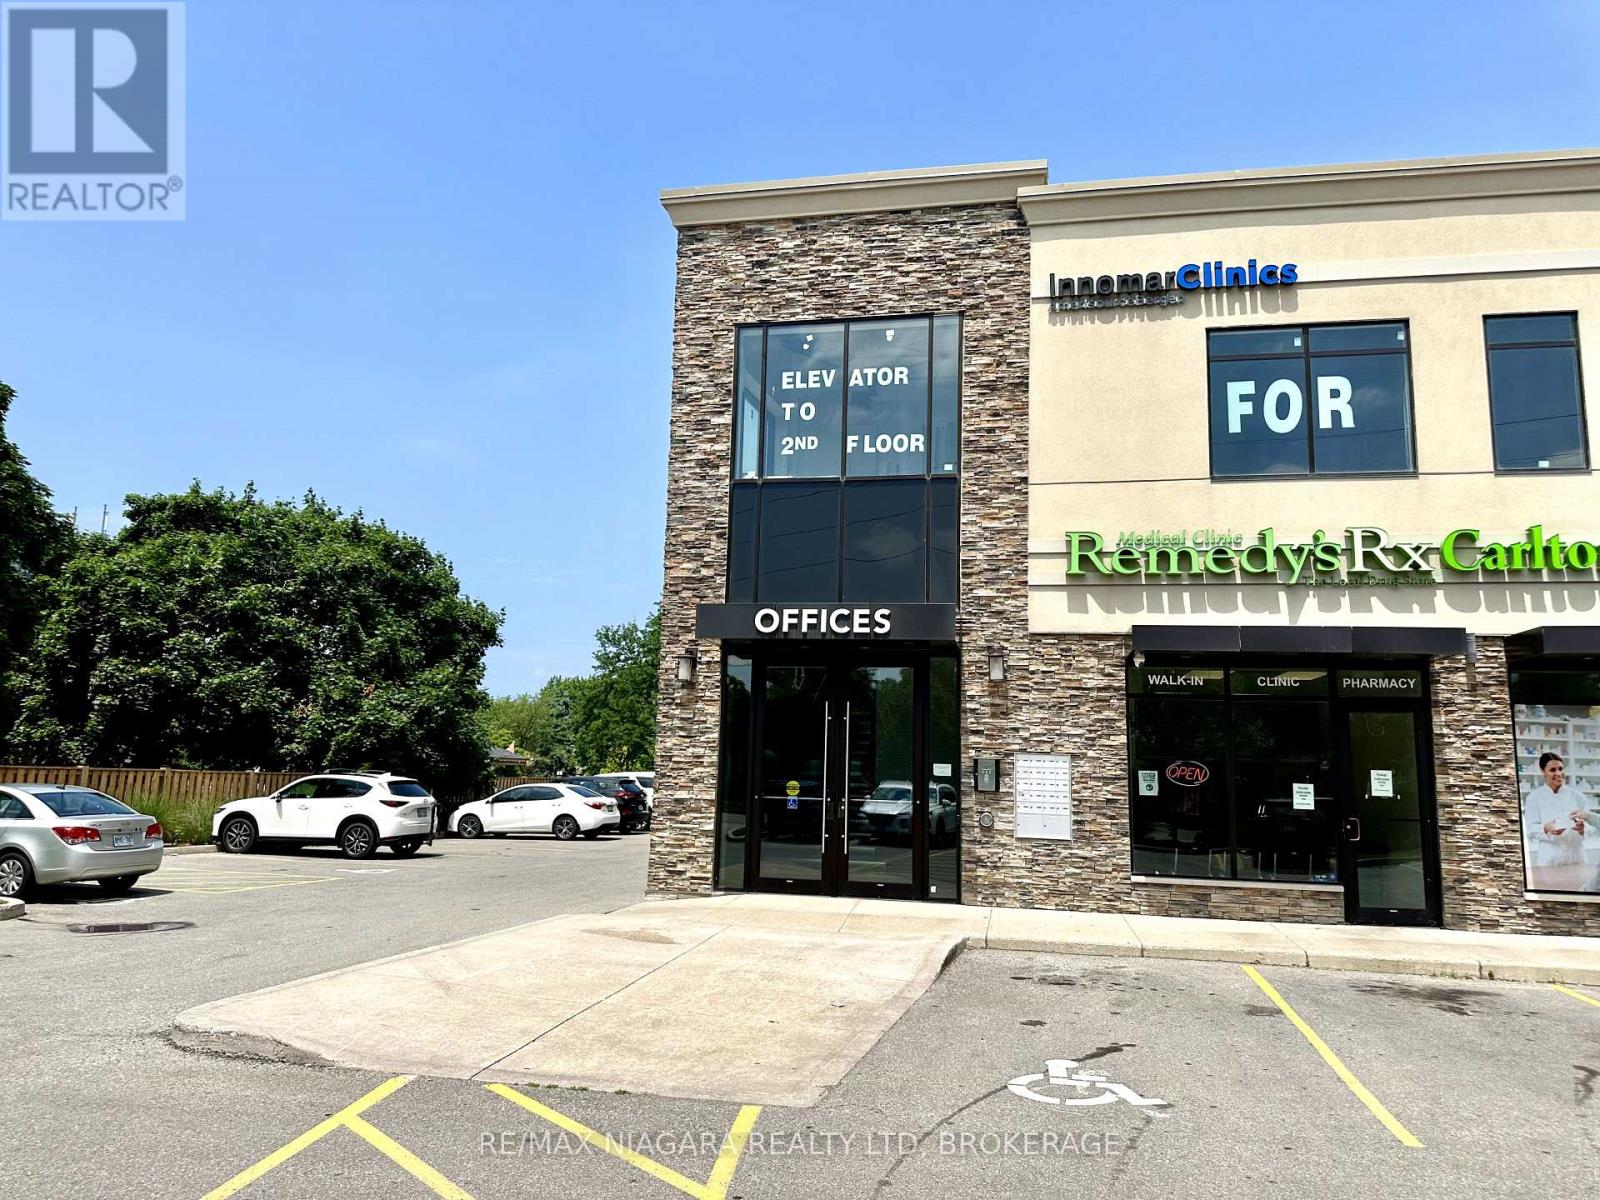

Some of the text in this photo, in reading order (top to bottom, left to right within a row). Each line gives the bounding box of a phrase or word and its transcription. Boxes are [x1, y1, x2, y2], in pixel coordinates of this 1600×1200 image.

[781, 402, 816, 421] TO
[1226, 376, 1355, 434] FOR
[781, 433, 925, 455] 2ND FLOOR
[1116, 528, 1243, 546] Medical Clinic
[1440, 524, 1600, 571] Carlto
[754, 608, 891, 634] OFFICES
[1148, 674, 1416, 689] WALK-IN CLINIC PHARMACY
[1168, 766, 1205, 781] OPEN
